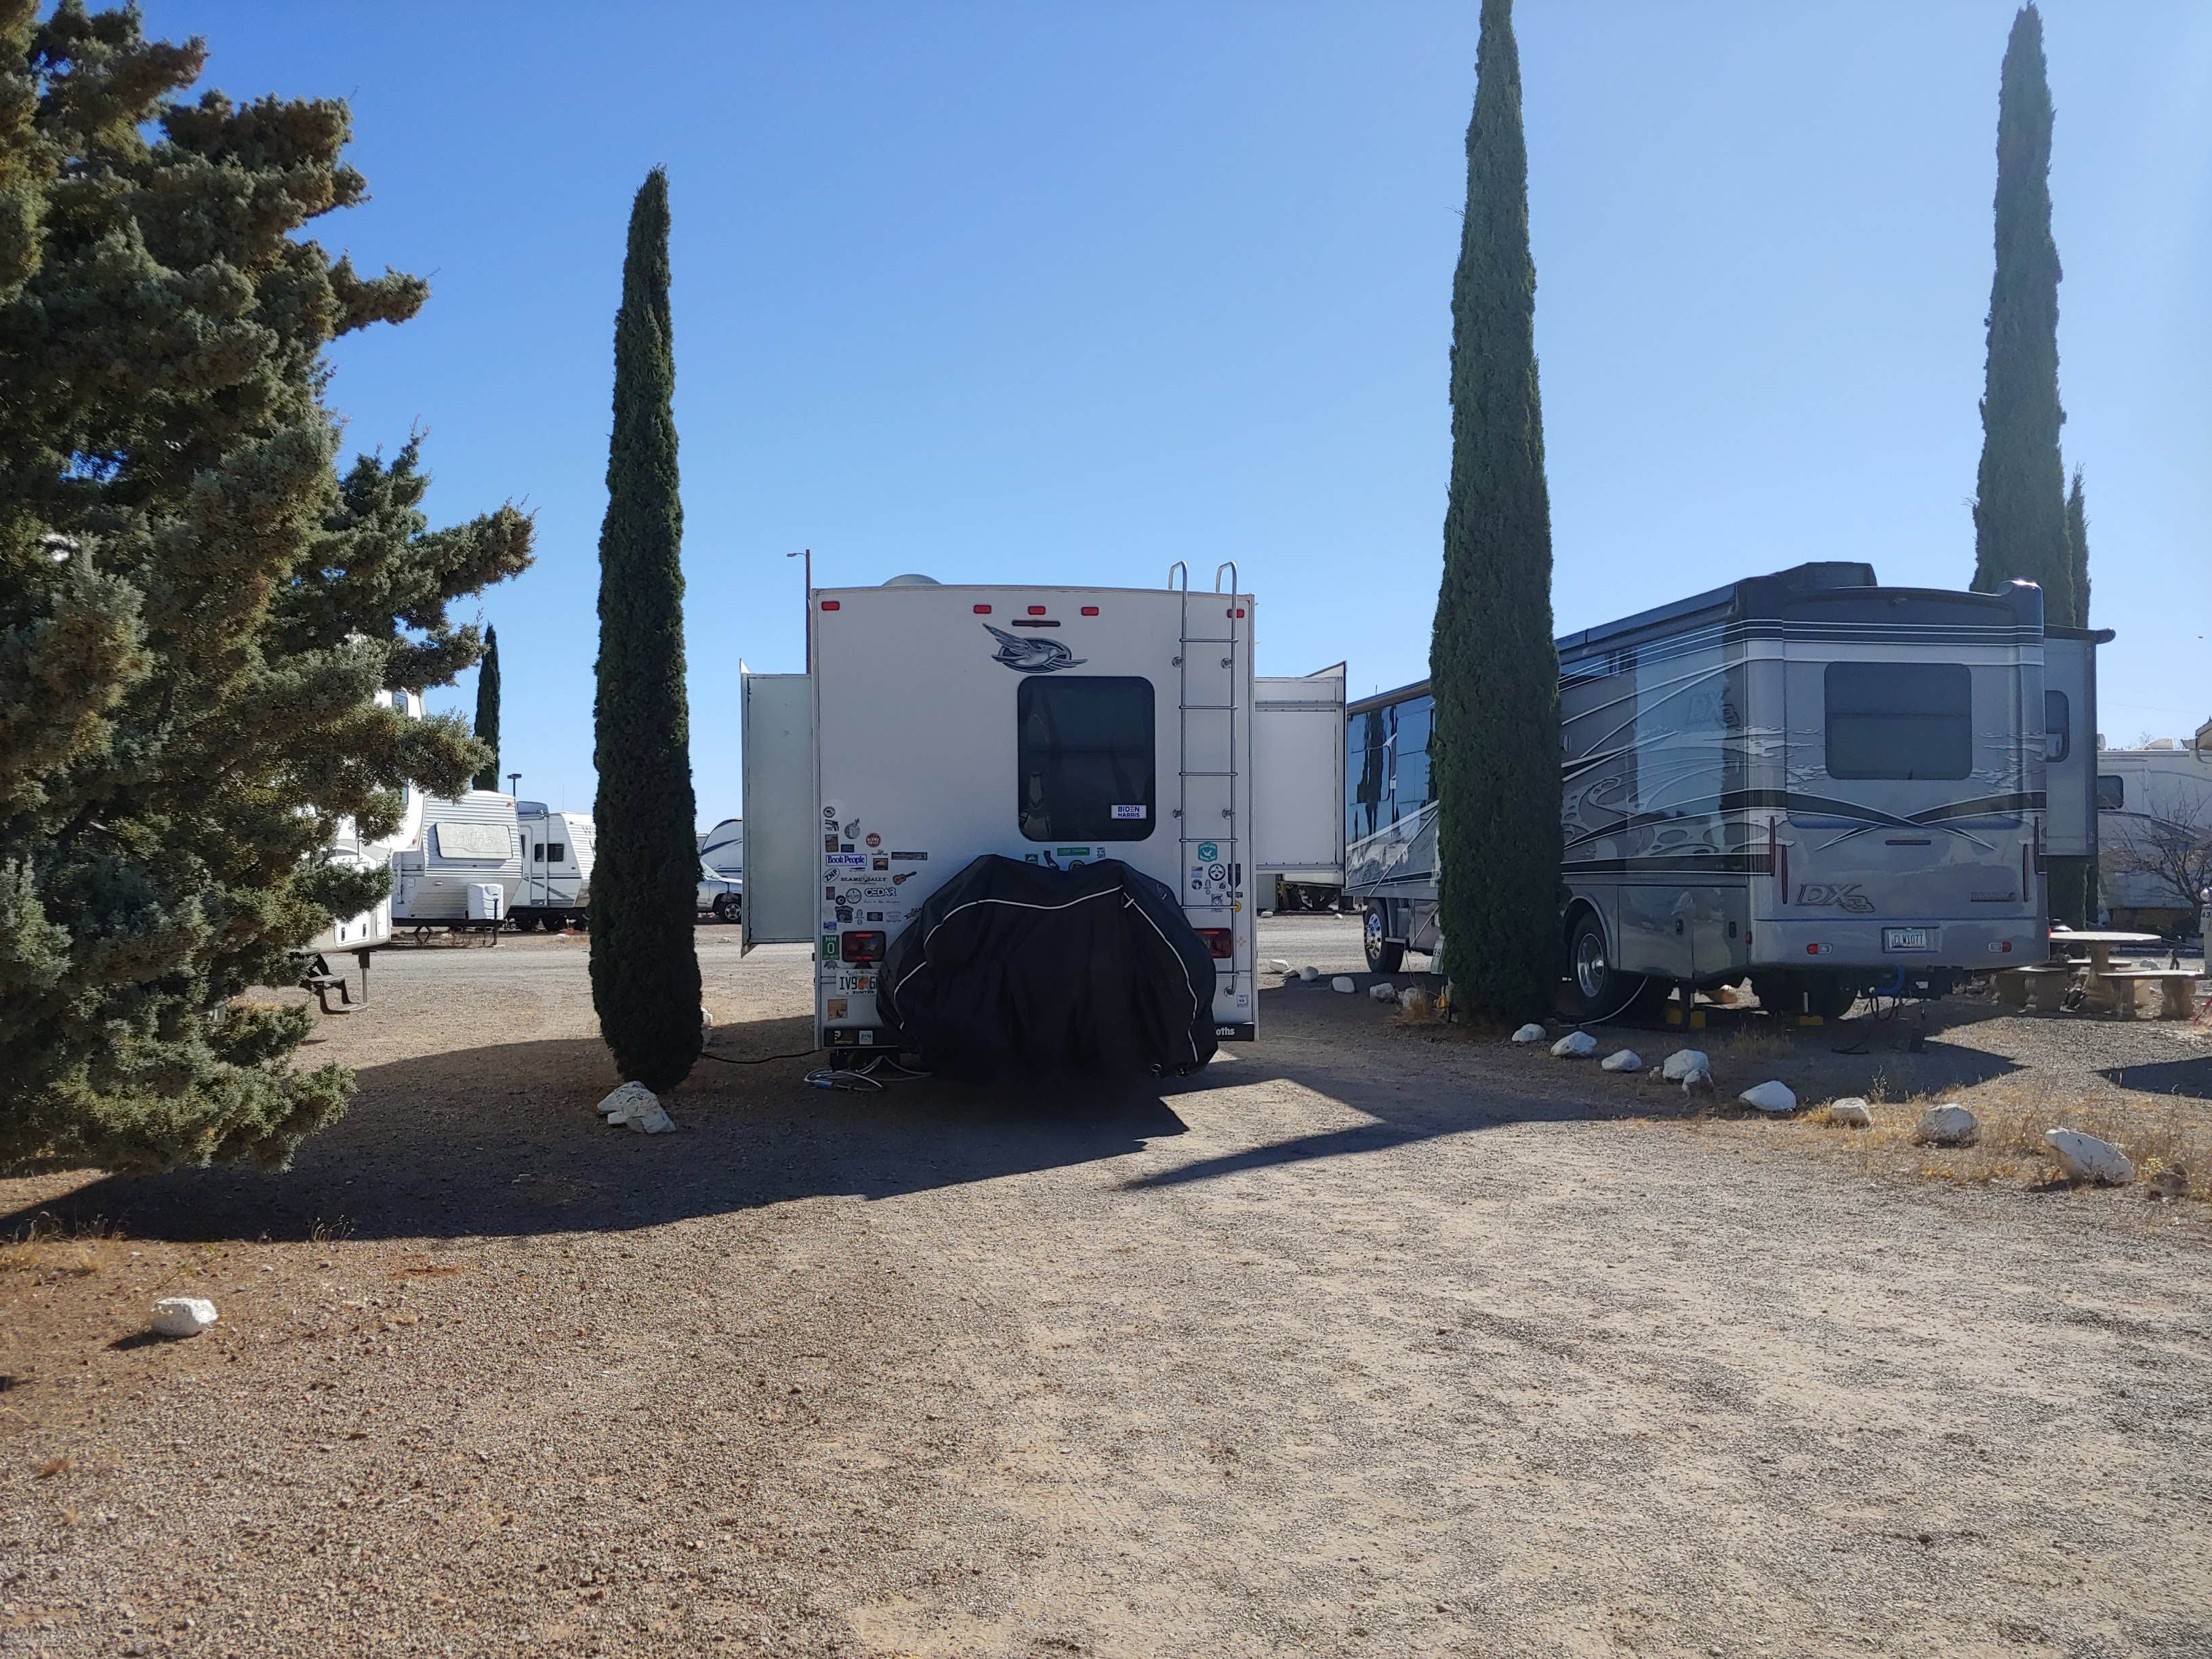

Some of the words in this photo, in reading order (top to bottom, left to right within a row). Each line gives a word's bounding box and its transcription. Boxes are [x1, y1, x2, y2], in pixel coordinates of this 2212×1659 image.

[827, 855, 844, 863] Book
[844, 855, 865, 864] People
[825, 869, 838, 881] ZNP
[865, 887, 897, 897] CEDAR
[1795, 884, 1875, 913] DX3
